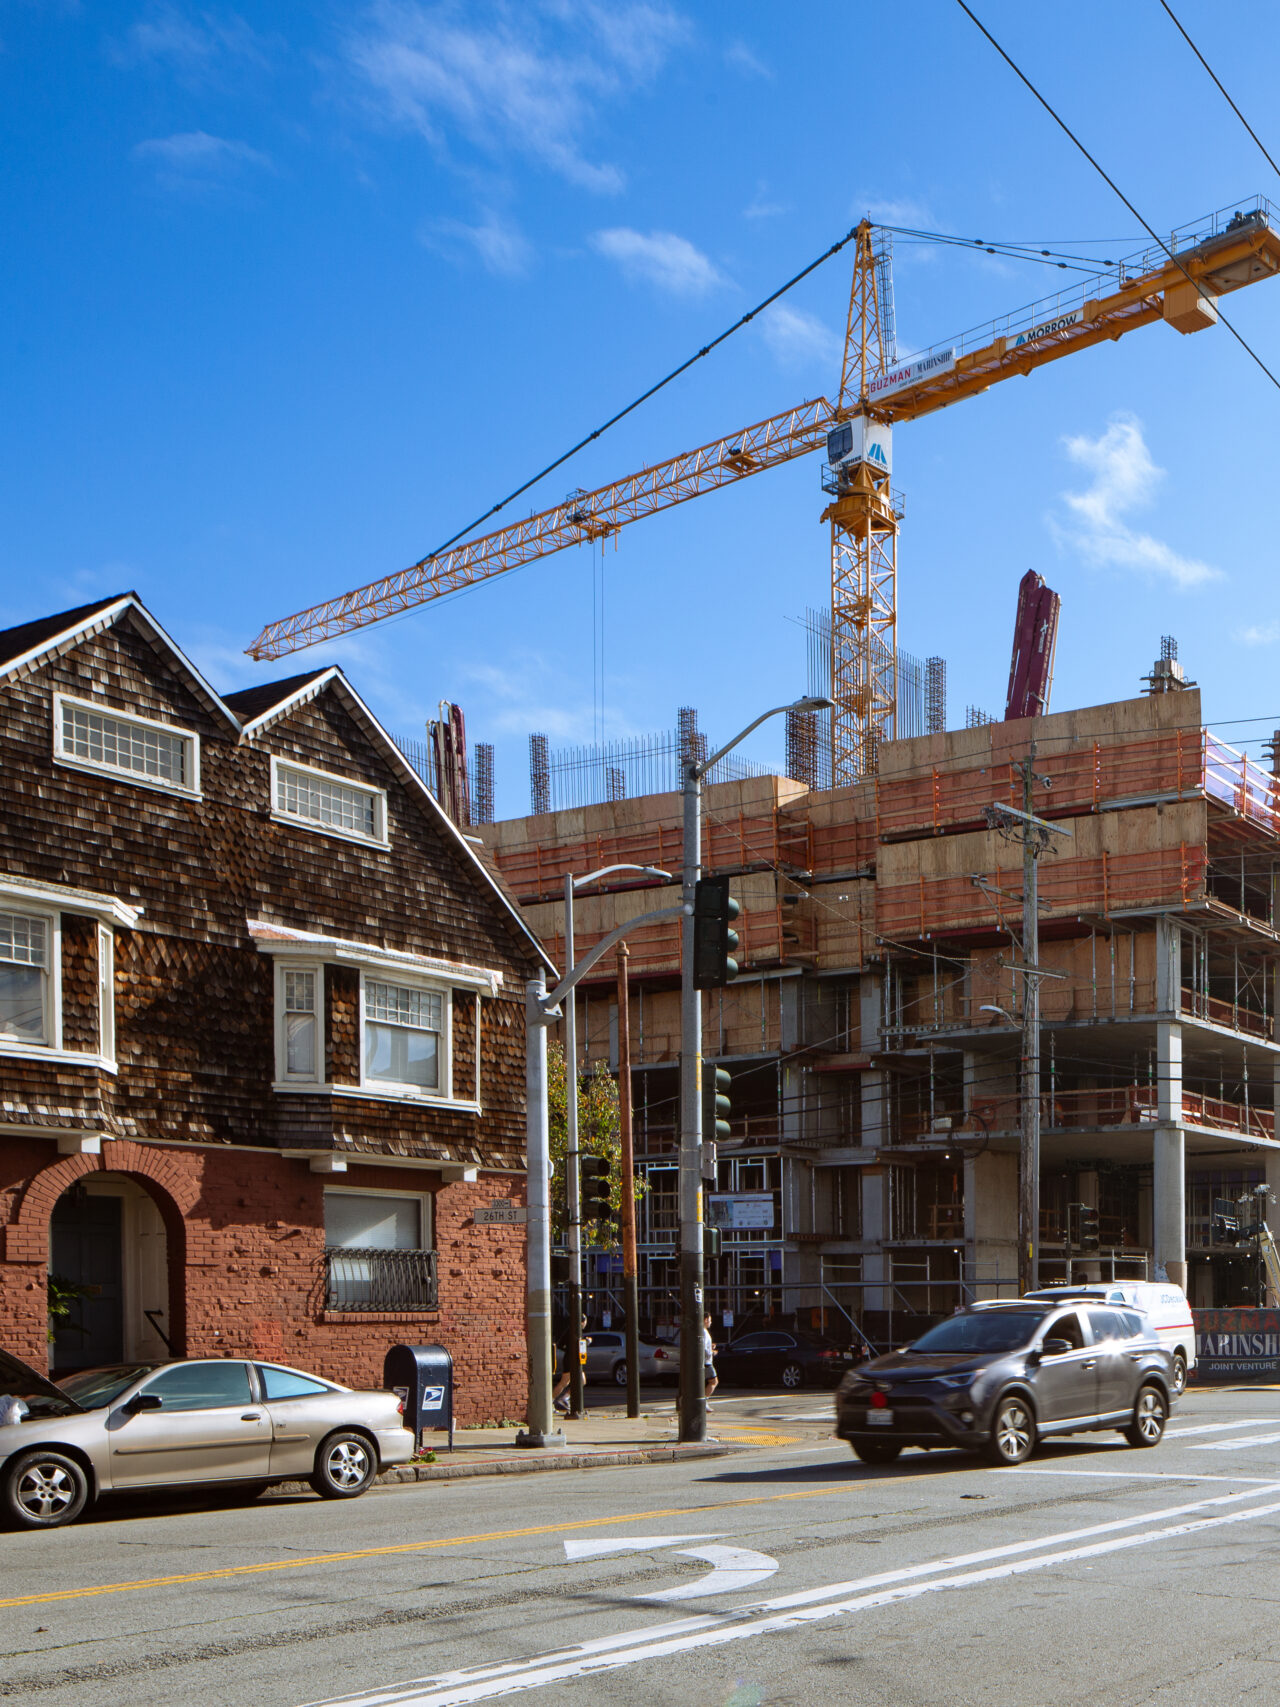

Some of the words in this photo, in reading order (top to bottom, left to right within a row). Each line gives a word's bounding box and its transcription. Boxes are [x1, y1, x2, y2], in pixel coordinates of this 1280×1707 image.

[1027, 314, 1078, 342] MORROW
[870, 368, 911, 393] GUZMAN
[917, 351, 953, 373] MARINSHIP
[483, 1211, 505, 1221] 26TH
[508, 1211, 517, 1220] ST
[1208, 1362, 1234, 1370] JOINT
[1236, 1361, 1277, 1371] VENTURE
